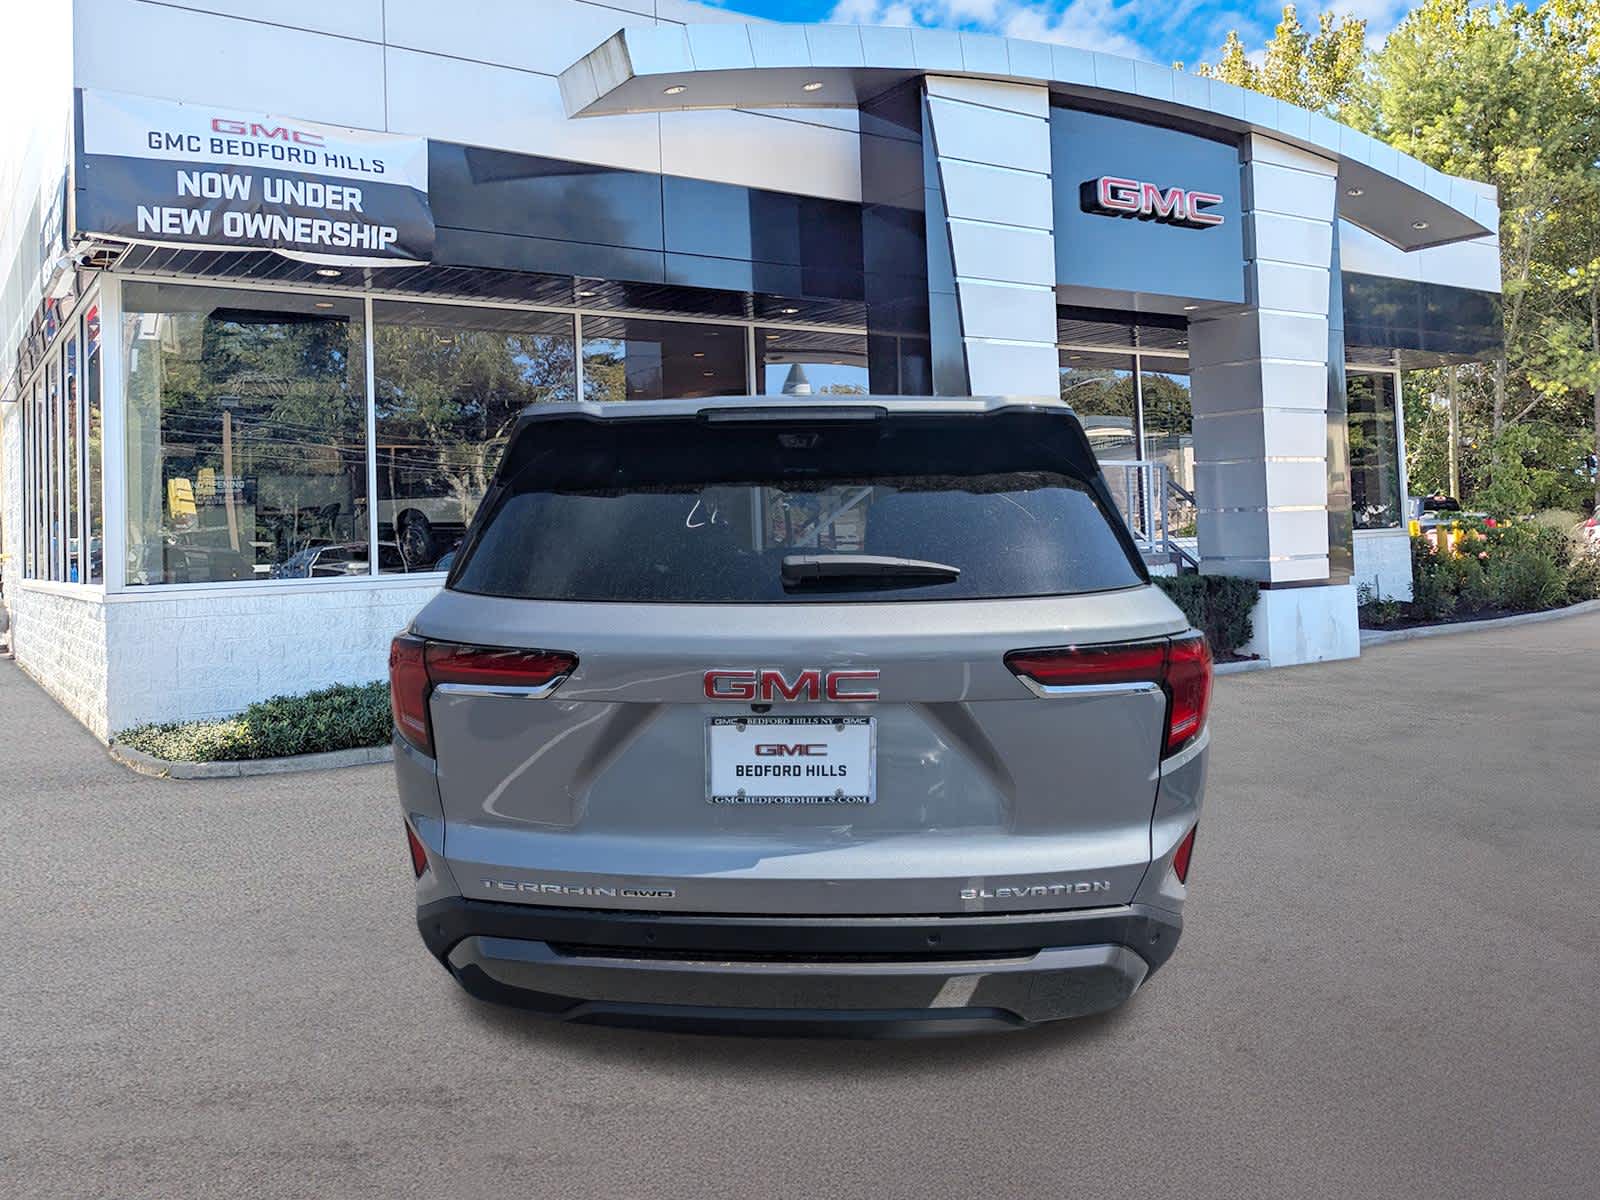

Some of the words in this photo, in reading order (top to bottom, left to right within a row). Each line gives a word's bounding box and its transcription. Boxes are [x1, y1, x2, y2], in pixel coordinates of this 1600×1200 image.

[211, 118, 326, 148] GMC
[148, 131, 200, 152] GMC
[210, 139, 316, 165] BEDFORD
[324, 154, 384, 174] HILLS
[176, 170, 252, 201] NOW
[263, 177, 364, 213] UNDER
[1097, 176, 1225, 225] GMC
[136, 206, 211, 236] NEW
[223, 211, 398, 250] OWNERSHIP
[703, 668, 881, 702] GMC
[714, 718, 738, 726] GMC
[747, 717, 790, 726] BEDFORD
[792, 717, 819, 726] HILLS
[842, 717, 867, 726] GMC
[754, 743, 828, 757] GMC
[736, 765, 801, 777] BEDFORD
[806, 765, 847, 777] HILLS
[480, 879, 617, 897] TERRAIN
[960, 881, 1111, 899] ELEVATION
